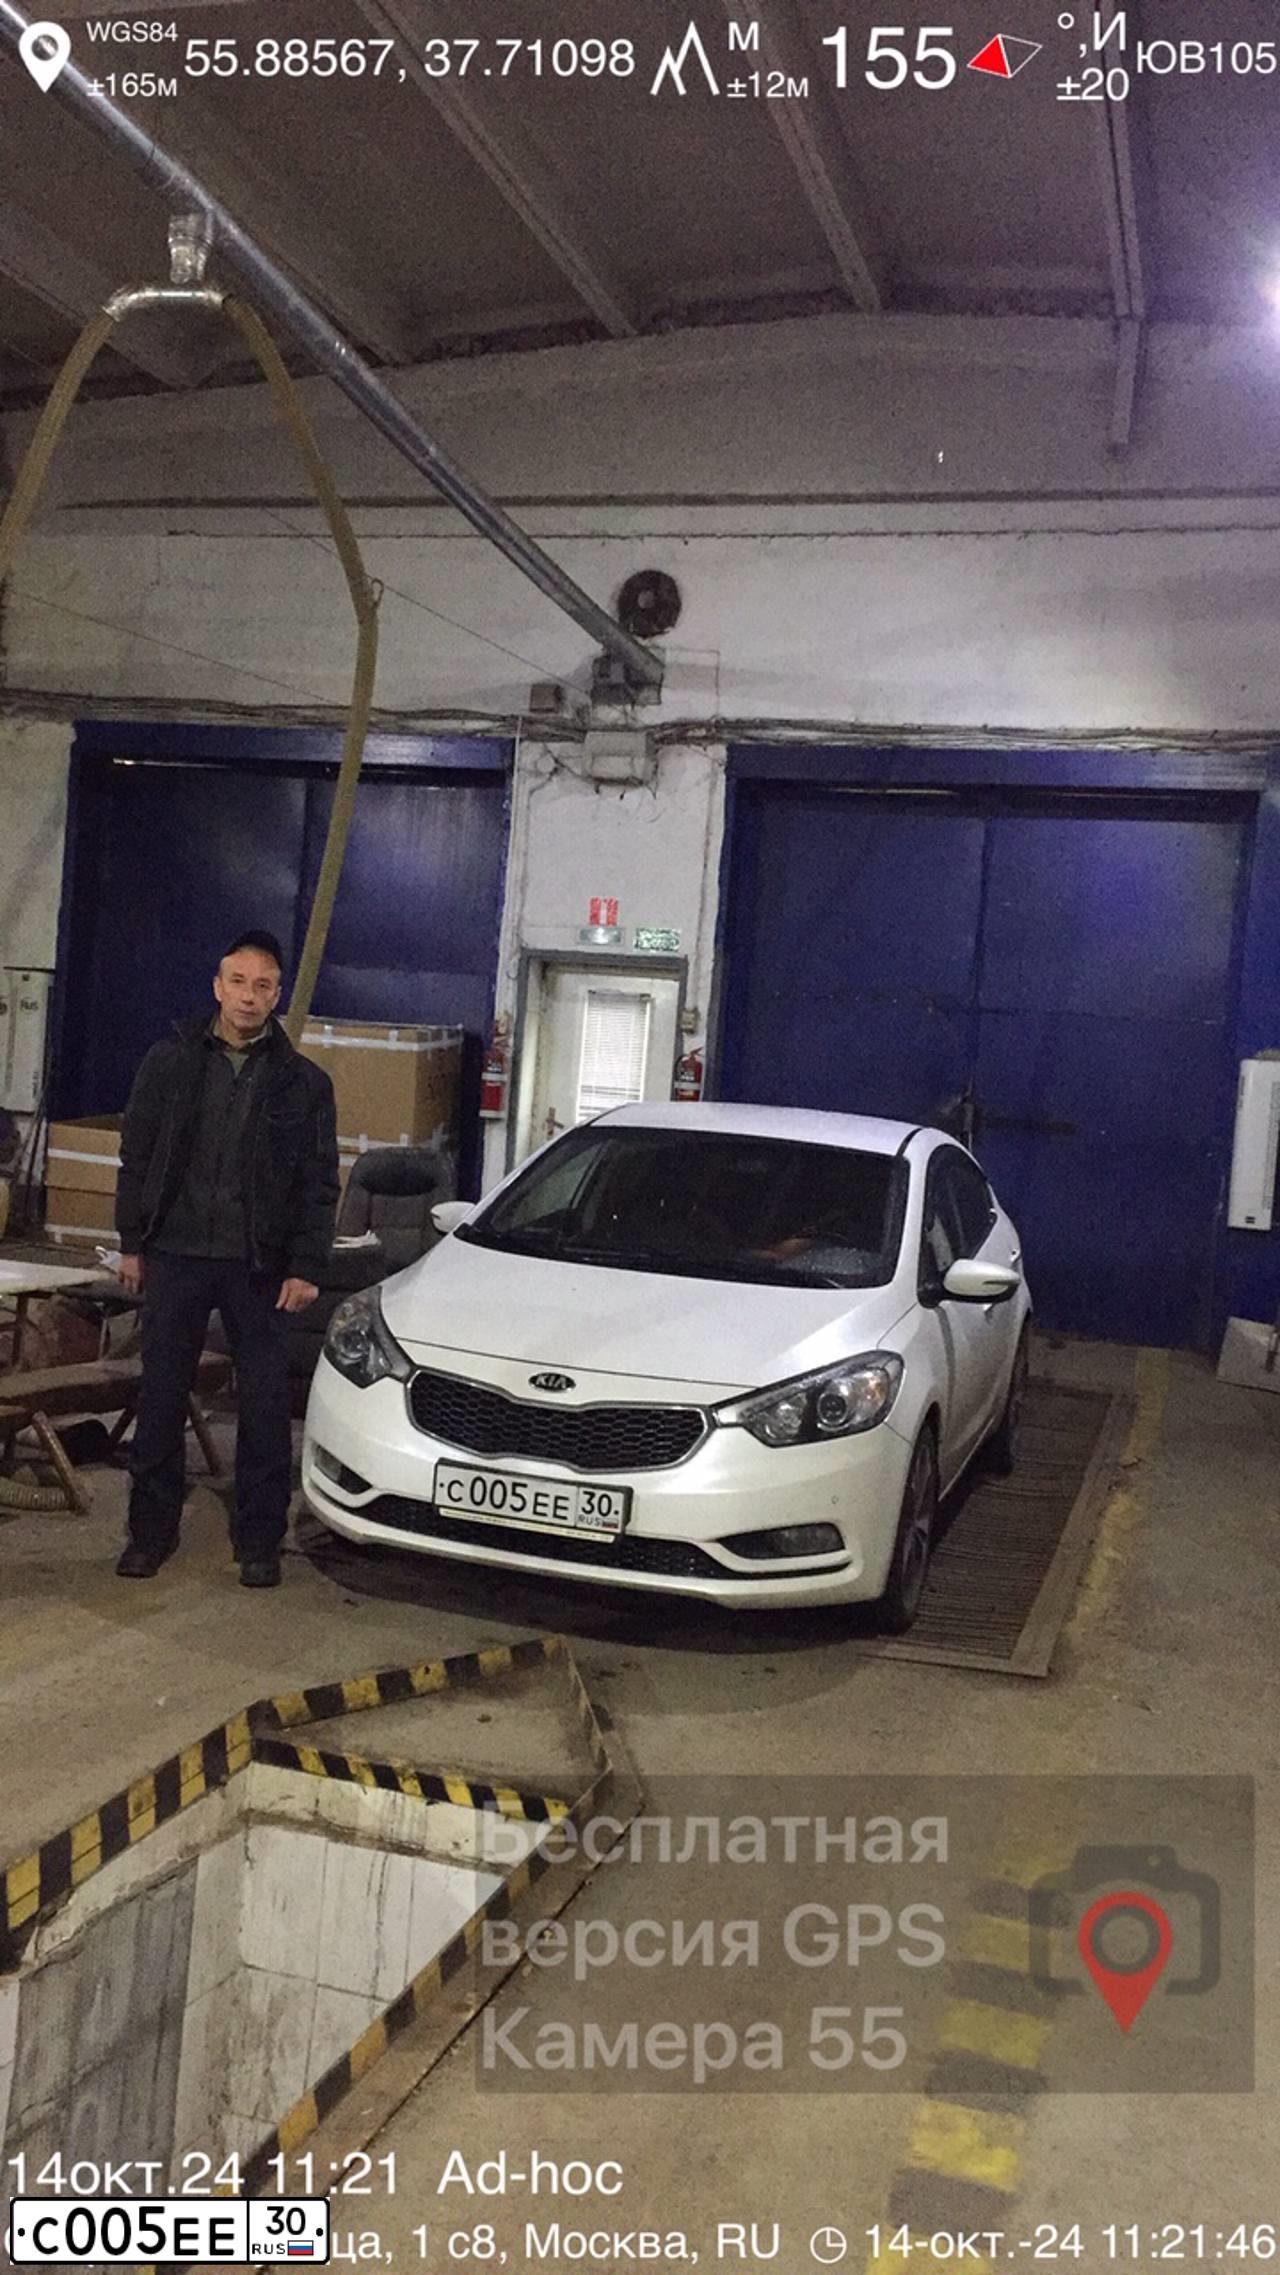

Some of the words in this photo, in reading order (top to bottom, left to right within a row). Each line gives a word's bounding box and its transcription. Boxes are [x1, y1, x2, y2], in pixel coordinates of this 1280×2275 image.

[536, 1375, 566, 1389] KIA
[581, 1490, 613, 1517] 30
[578, 1514, 600, 1527] RUS
